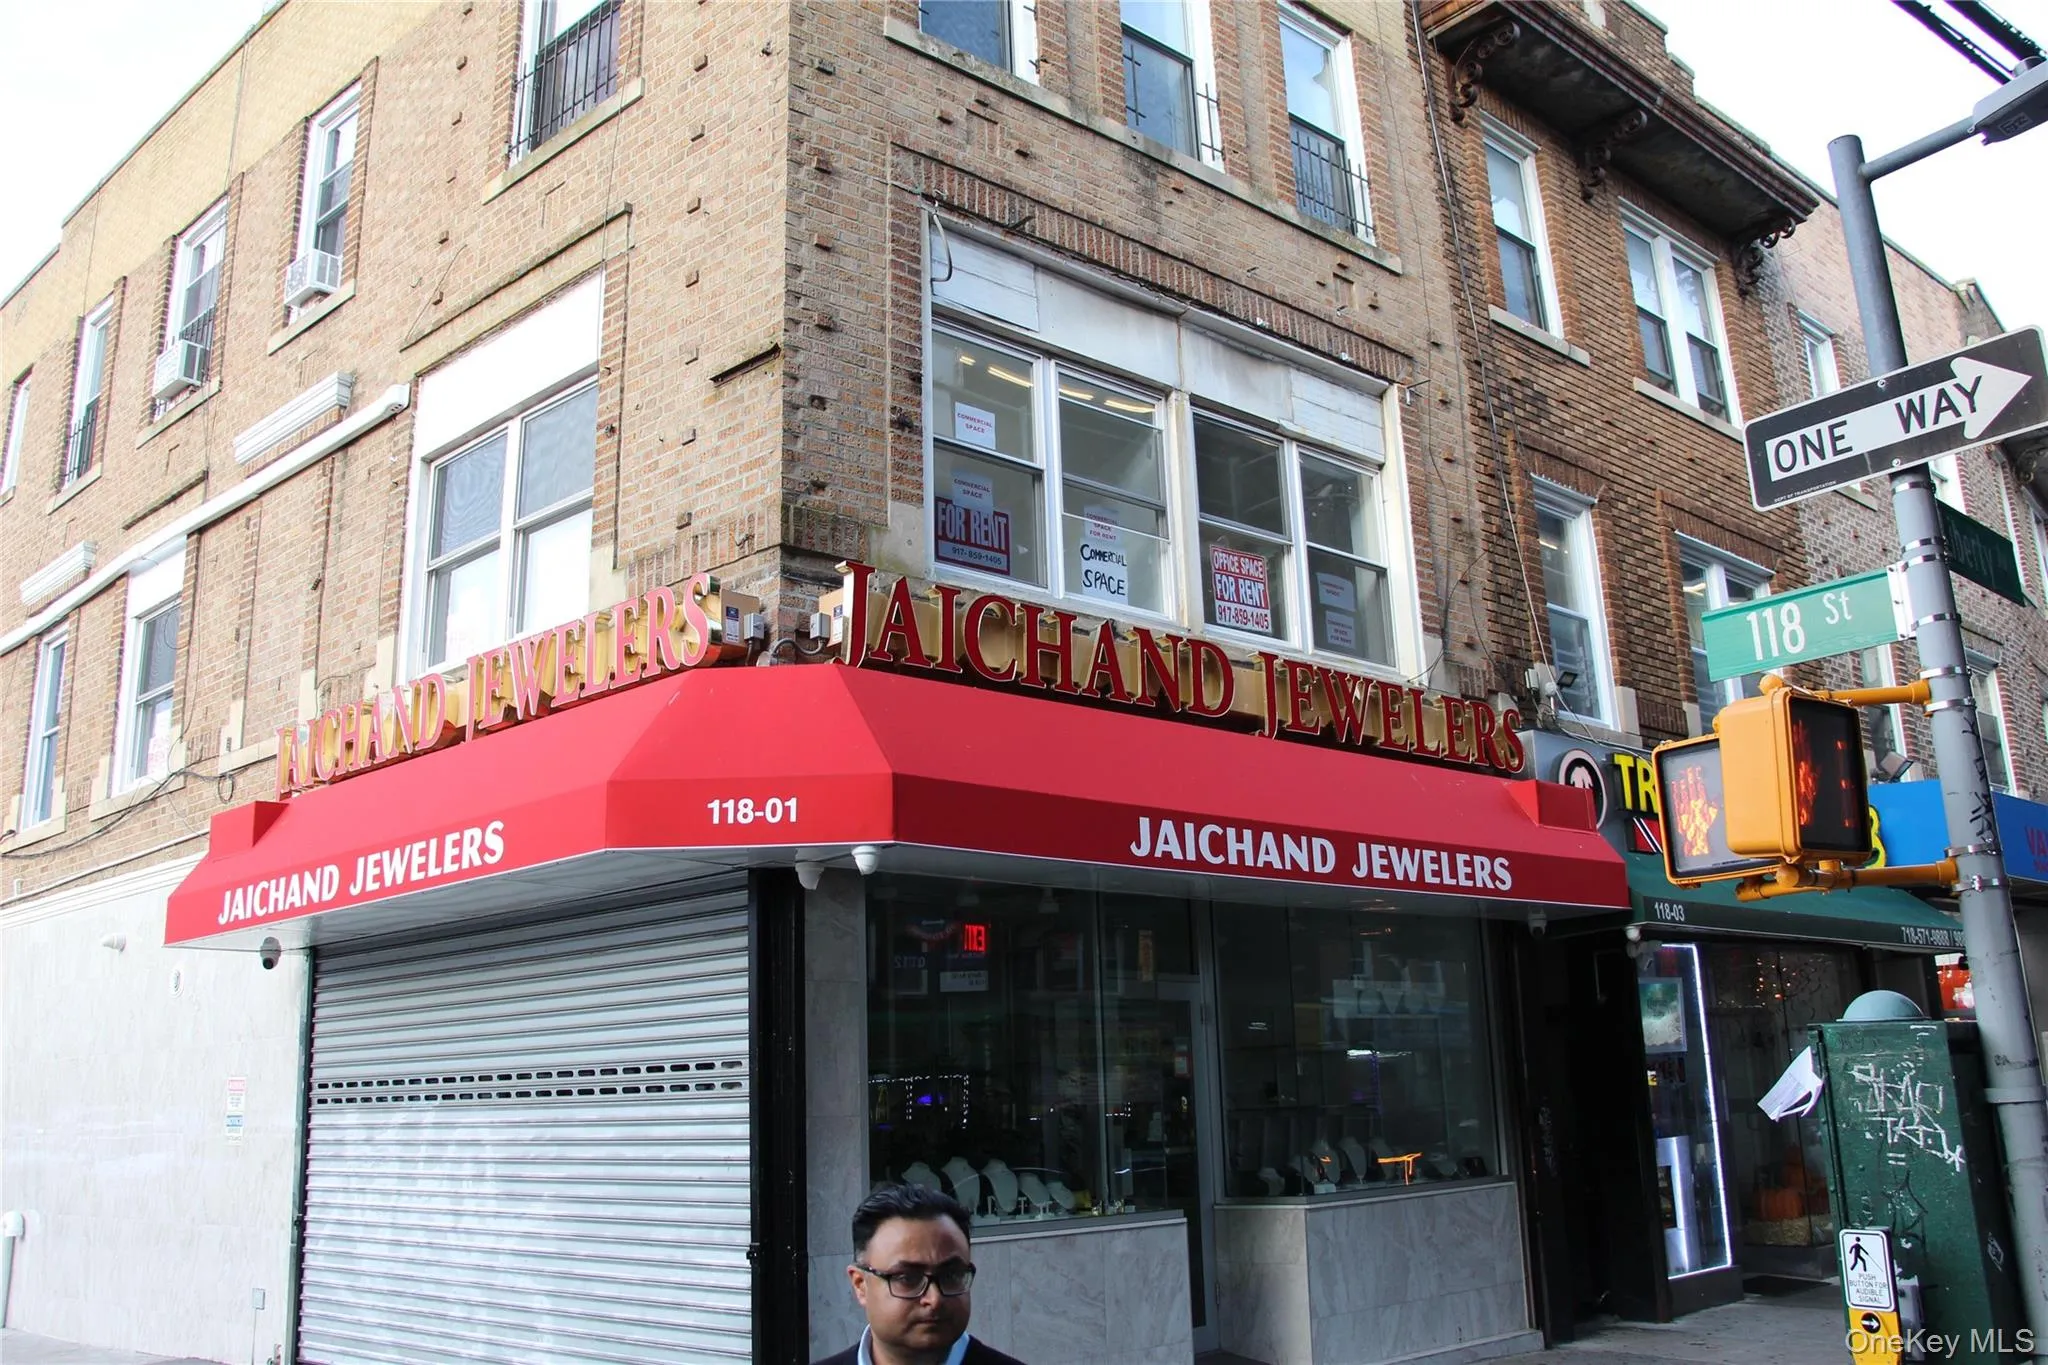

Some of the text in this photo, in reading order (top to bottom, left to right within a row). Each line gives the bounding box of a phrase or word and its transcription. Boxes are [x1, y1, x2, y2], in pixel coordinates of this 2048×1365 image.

[957, 412, 993, 428] COMMERCIAL
[965, 423, 985, 434] SPACE
[1774, 374, 1983, 474] ONE WAY
[953, 478, 991, 493] COMMERCIAL
[962, 488, 983, 499] SPACE
[938, 501, 1007, 551] FOR RENT
[952, 547, 1002, 565] 917-859-1405
[1213, 551, 1264, 579] OFFICE SPACE
[1082, 569, 1126, 596] SPACE
[1215, 574, 1265, 607] FOR RENT
[1217, 604, 1269, 630] 917-859-1405
[1746, 592, 1853, 661] 118 St
[834, 560, 1526, 774] JAICHAND JEWELERS
[275, 573, 712, 800] JAICHAND JEWELERS
[707, 797, 798, 825] 118-01
[1129, 816, 1512, 891] JAICHAND JEWELERS
[218, 820, 505, 925] JAICHAND JEWELERS
[1655, 901, 1685, 921] 118-03
[1849, 1280, 1873, 1288] BUTTON
[1856, 1288, 1883, 1296] AUDIBLE
[1859, 1296, 1881, 1304] SIGNAL
